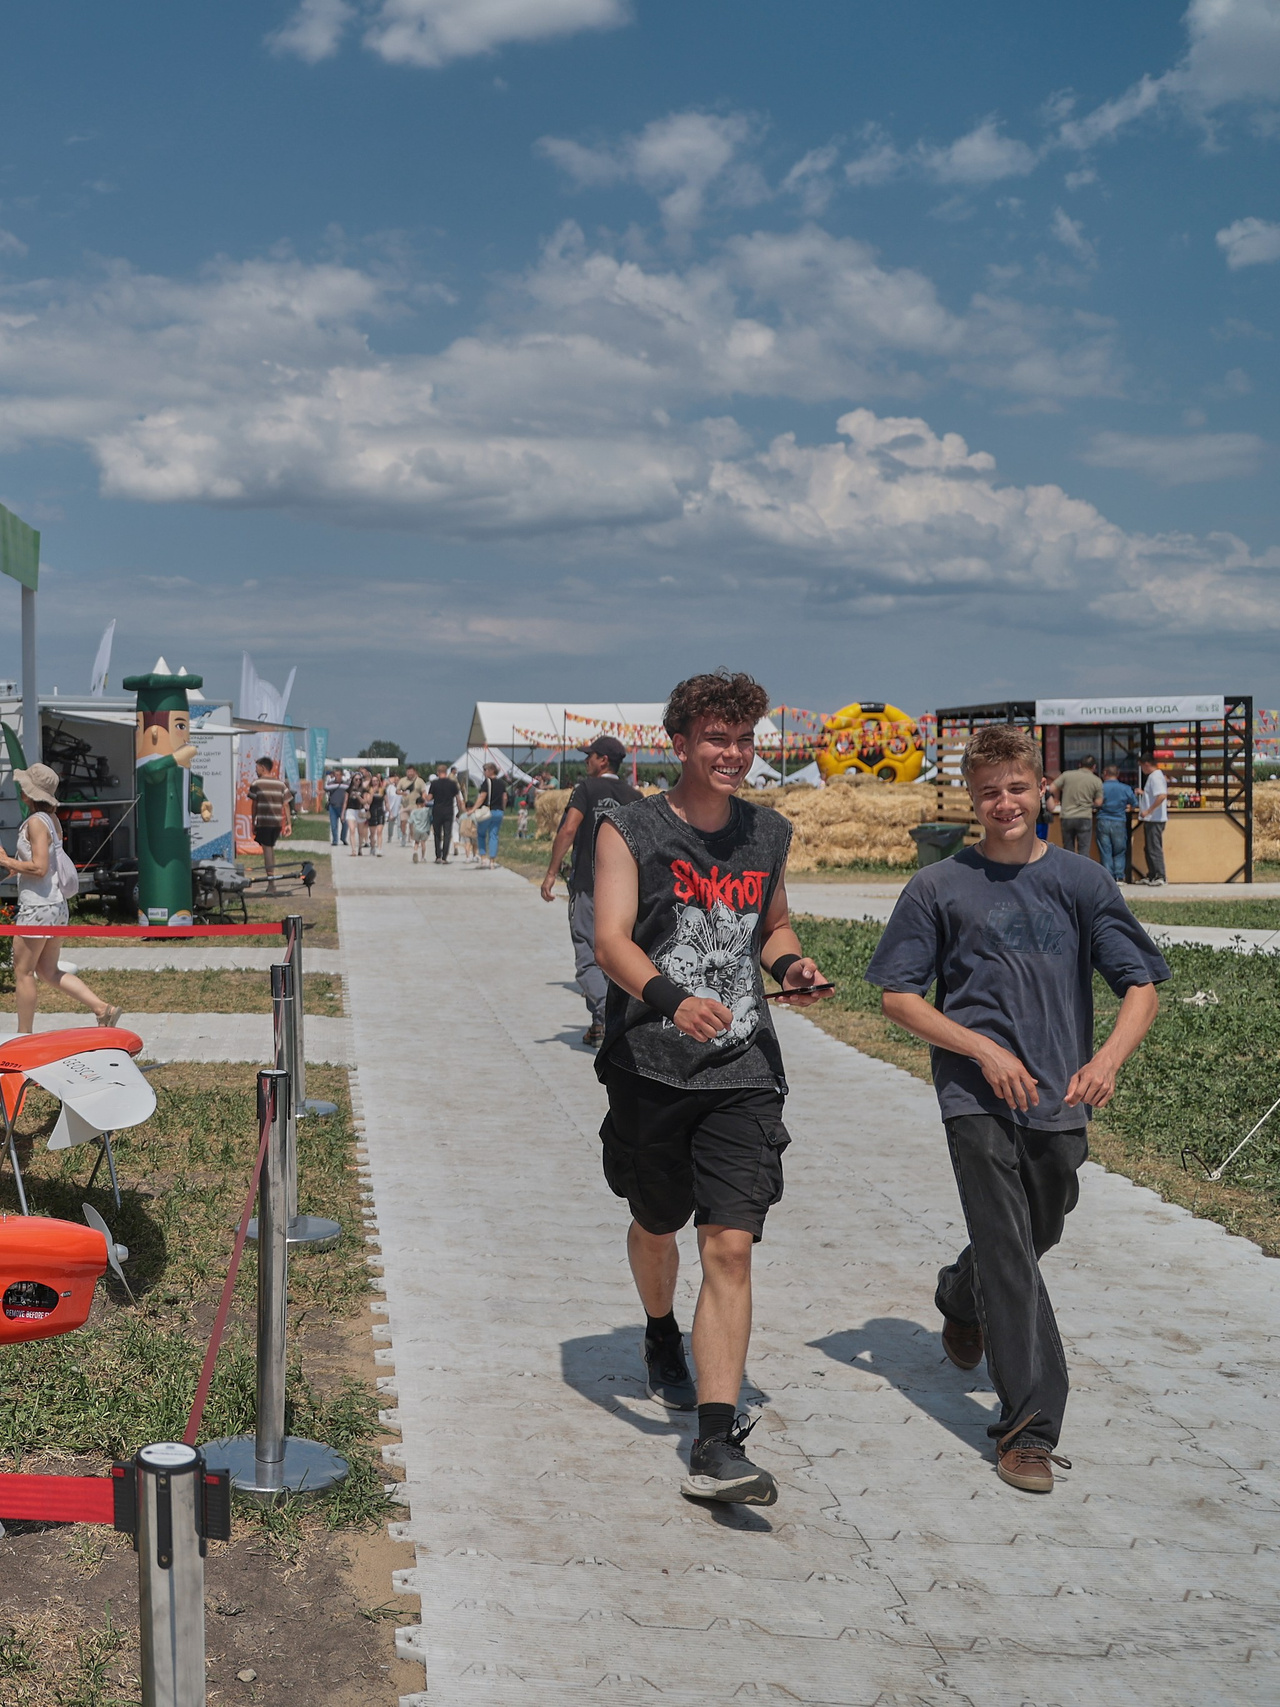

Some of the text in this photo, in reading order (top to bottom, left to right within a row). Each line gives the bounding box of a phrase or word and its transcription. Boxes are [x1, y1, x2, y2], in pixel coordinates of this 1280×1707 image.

[1080, 705, 1143, 716] ПИТЬЕВАЯ
[1146, 703, 1179, 714] ВОДА
[25, 1310, 45, 1319] BEFORE
